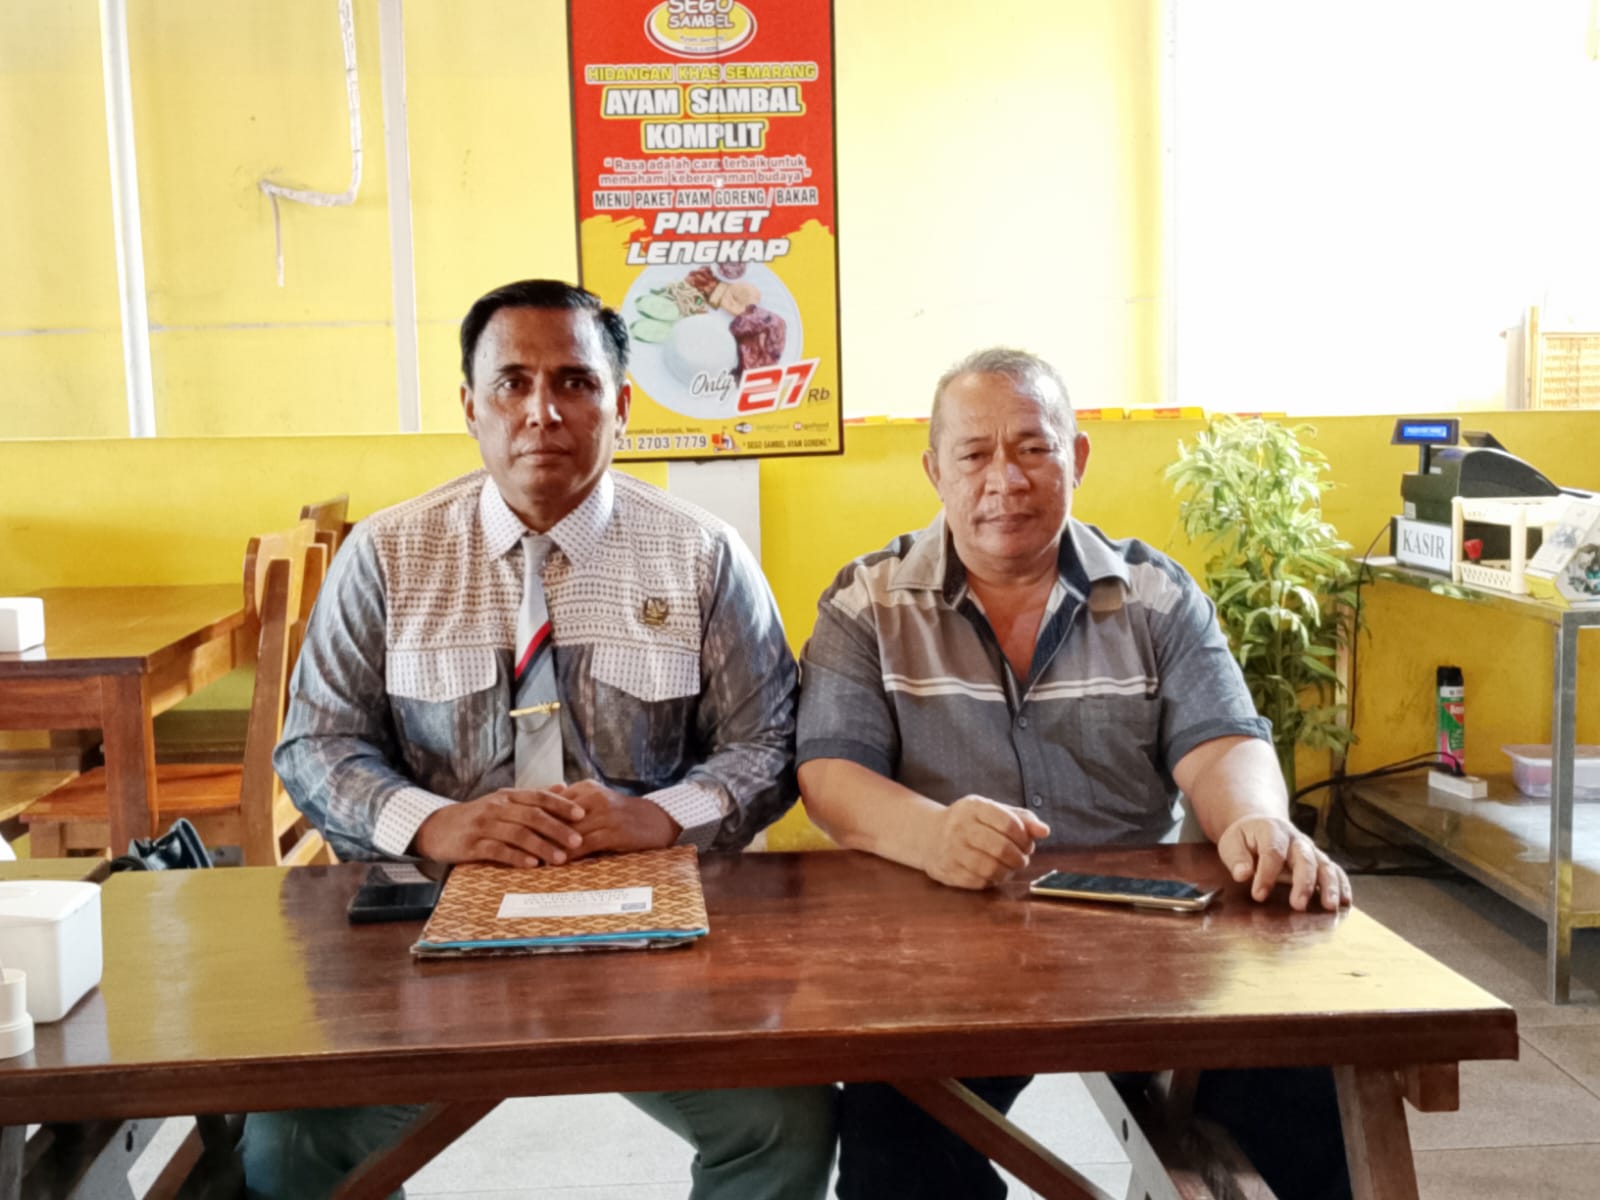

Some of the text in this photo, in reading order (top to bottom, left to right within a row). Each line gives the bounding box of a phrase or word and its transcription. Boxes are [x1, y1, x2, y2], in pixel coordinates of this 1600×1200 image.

[669, 15, 733, 27] SAMBEL
[587, 64, 816, 81] HIDANGAN KHAS SEMARANG
[606, 88, 801, 115] AYAM SAMBAL
[646, 124, 763, 149] KOMPLIT
[648, 158, 689, 170] adalah
[693, 160, 720, 170] cara
[723, 158, 766, 169] terbaik
[770, 157, 806, 168] untuk
[600, 173, 668, 185] memahami
[594, 192, 631, 208] MENU
[635, 191, 672, 207] PAKET
[677, 191, 710, 206] AYAM
[714, 190, 764, 206] GORENG
[777, 189, 818, 204] BAKAR
[653, 211, 769, 235] PAKET
[626, 239, 790, 265] LENGKAP
[692, 360, 830, 414] Only 27 Rb
[638, 437, 670, 449] 2703
[674, 435, 706, 448] 7779
[1403, 529, 1445, 560] KASIR
